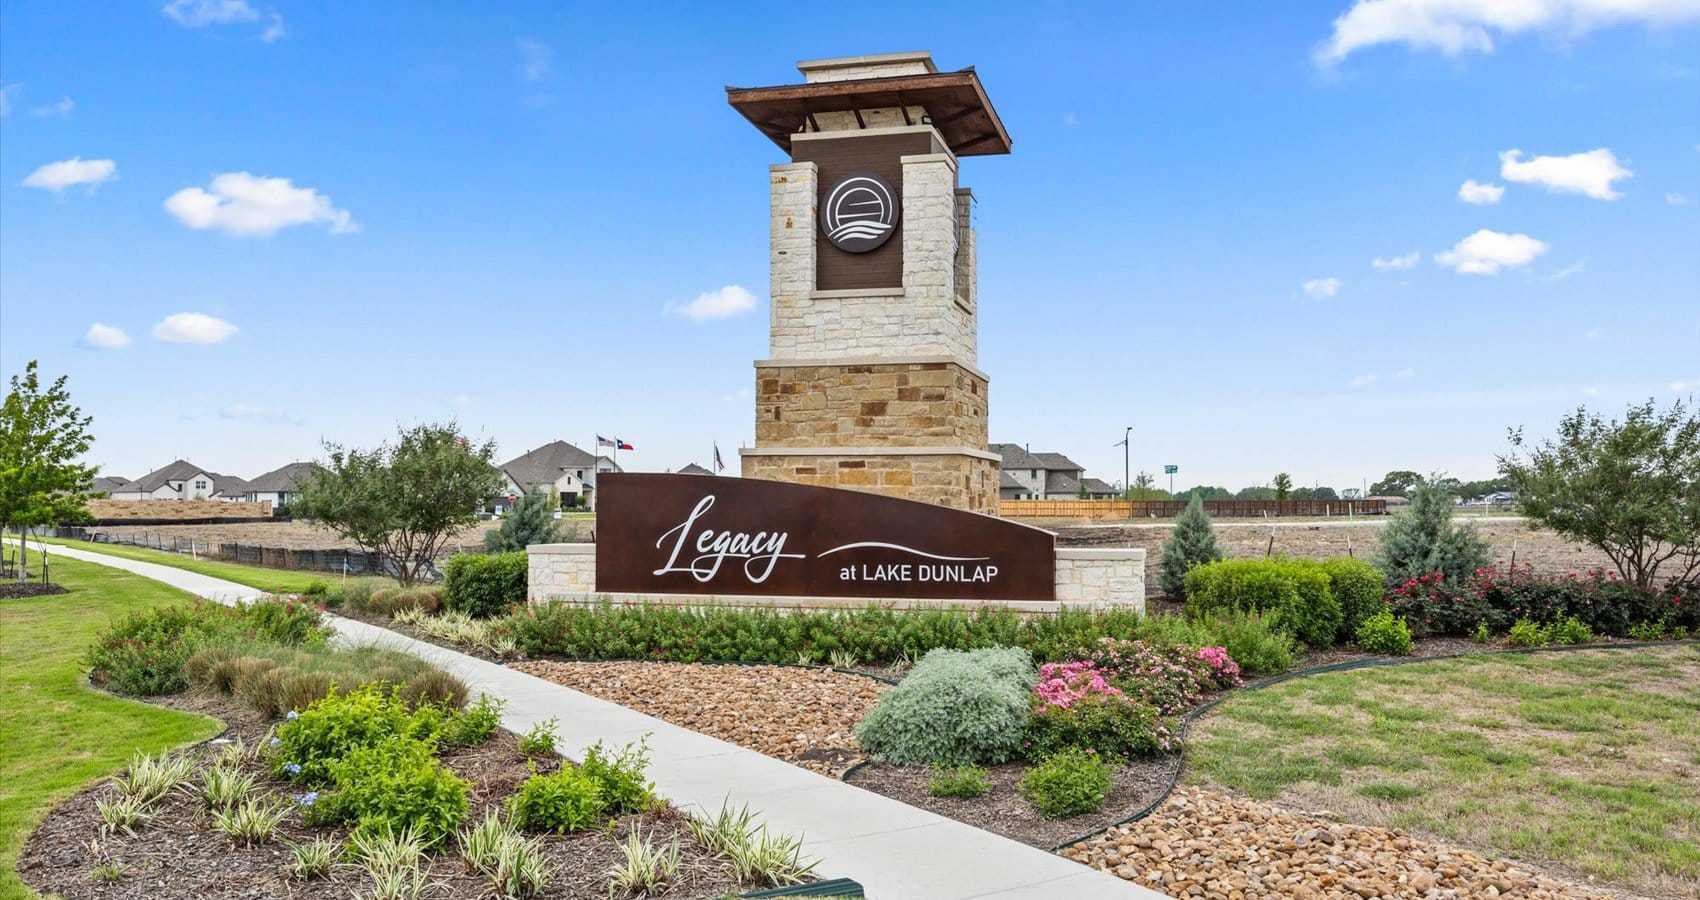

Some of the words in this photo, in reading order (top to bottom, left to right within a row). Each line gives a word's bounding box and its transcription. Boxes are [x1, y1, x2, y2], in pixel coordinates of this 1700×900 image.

[653, 494, 806, 583] Legacy
[839, 564, 857, 581] at
[863, 564, 912, 582] LAKE
[918, 564, 999, 583] DUNLAP
